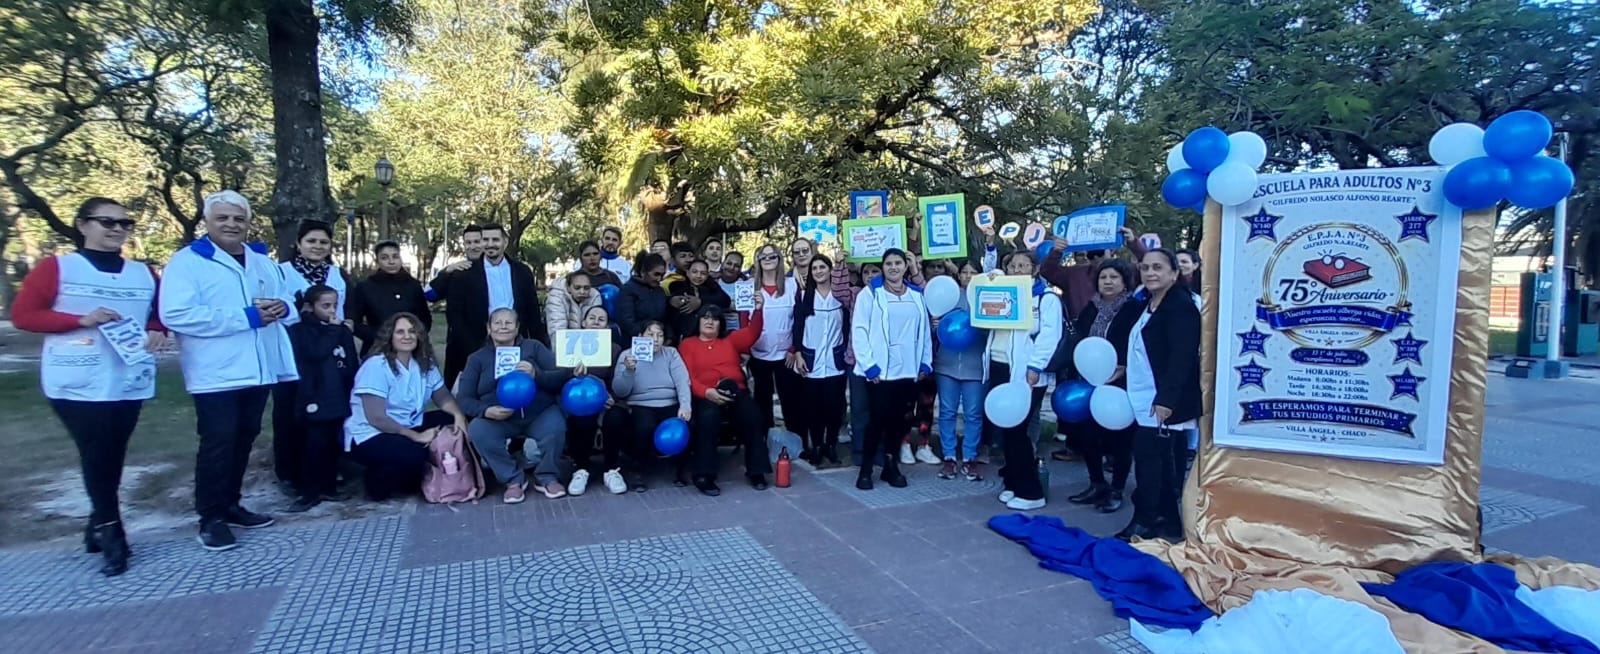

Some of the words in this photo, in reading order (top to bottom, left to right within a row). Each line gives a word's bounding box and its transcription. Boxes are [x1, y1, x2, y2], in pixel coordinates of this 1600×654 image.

[1309, 176, 1340, 189] PARA
[1343, 175, 1403, 190] ADULTOS
[1345, 194, 1380, 202] ALFONSO
[978, 209, 991, 225] E
[1003, 226, 1017, 236] P
[1029, 229, 1040, 243] J
[1303, 240, 1333, 250] GILFREDO
[1310, 288, 1387, 303] Aniversario
[565, 331, 599, 356] 75
[1305, 368, 1351, 377] HORARIOS:
[1259, 402, 1271, 410] TE
[1272, 402, 1325, 411] ESPERAMOS
[1327, 405, 1351, 413] PARA
[1353, 407, 1399, 420] TERMINAR
[1291, 411, 1334, 420] ESTUDIOS
[1335, 414, 1385, 426] PRIMARIOS
